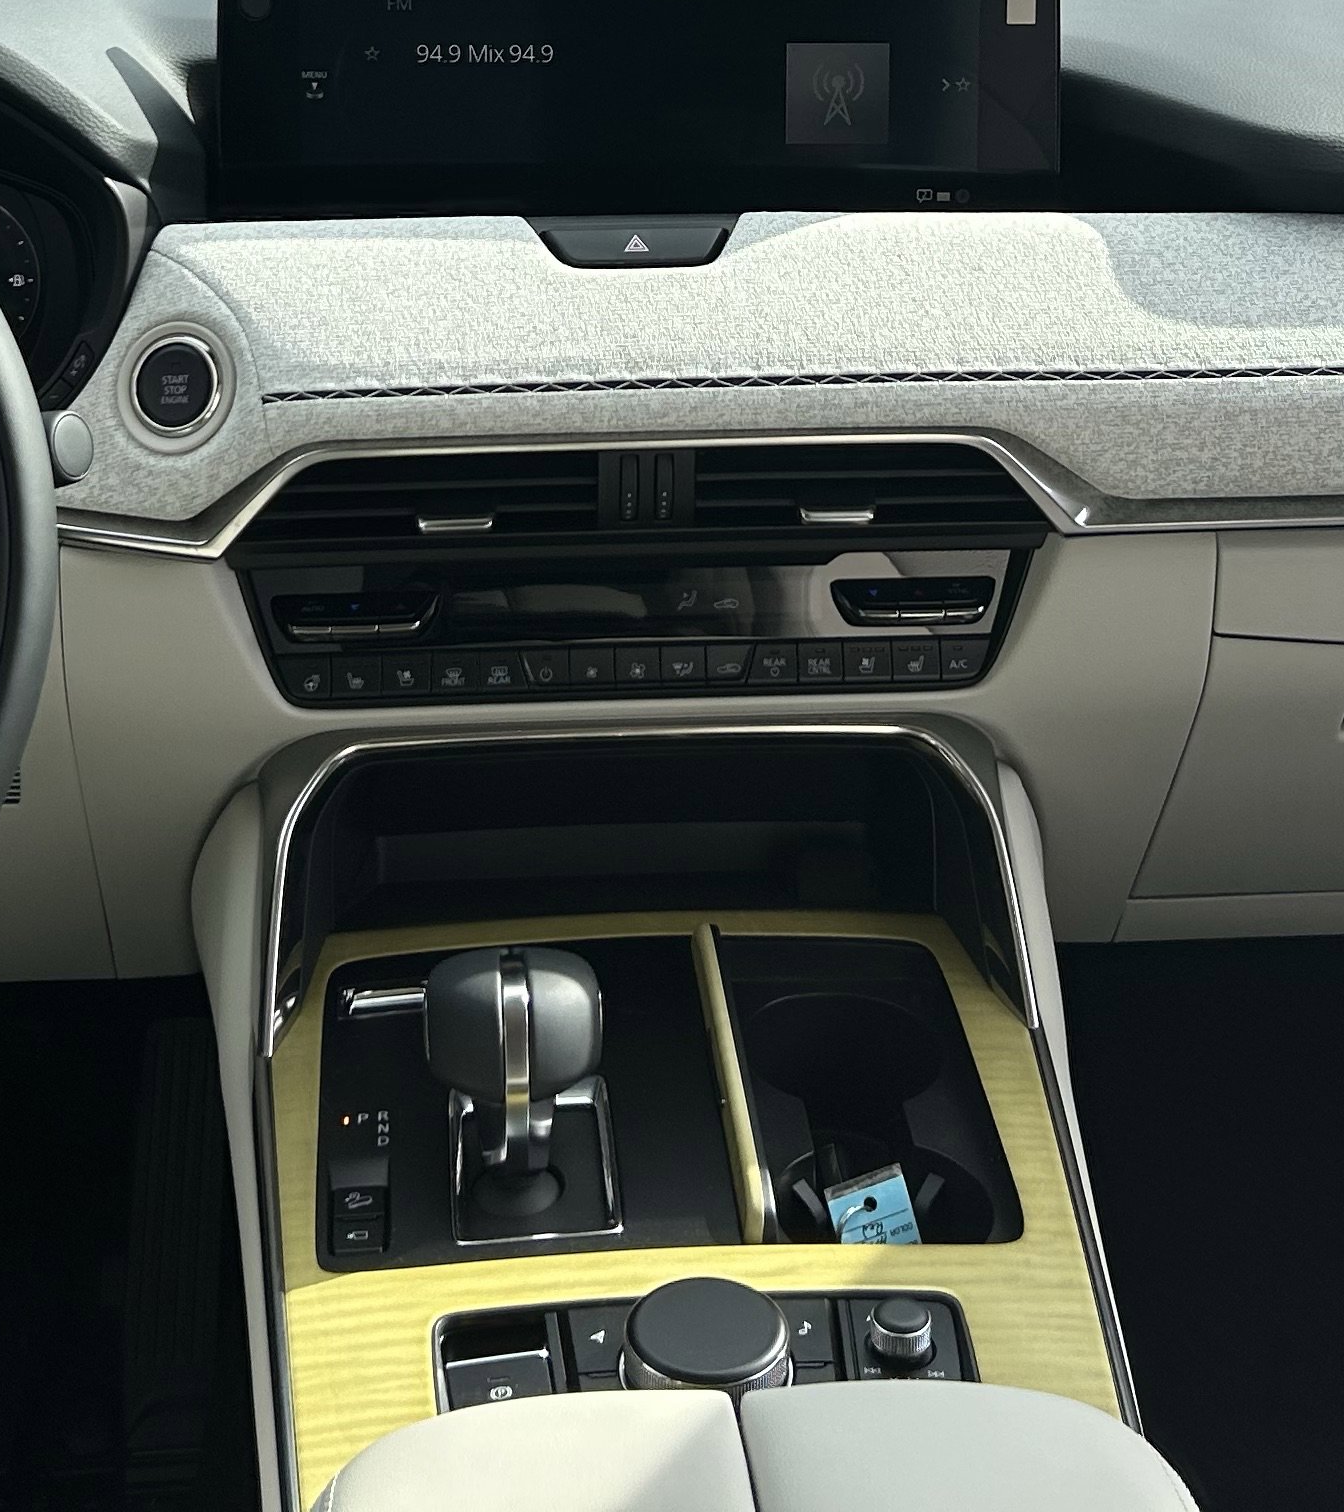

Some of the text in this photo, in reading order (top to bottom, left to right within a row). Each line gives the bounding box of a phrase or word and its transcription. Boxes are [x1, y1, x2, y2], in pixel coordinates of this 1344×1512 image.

[416, 44, 554, 63] 94.9 Mix 94.9
[161, 374, 189, 384] START
[164, 385, 187, 395] STOP
[160, 395, 189, 404] ENGINE
[763, 657, 786, 667] REAR
[808, 658, 831, 666] REAR
[949, 659, 968, 670] A/C
[441, 676, 465, 687] FRONT
[487, 676, 511, 685] REAR
[358, 1113, 369, 1125] P
[378, 1110, 389, 1122] R
[378, 1123, 389, 1134] N
[377, 1135, 390, 1147] D
[889, 1221, 914, 1237] COLOR
